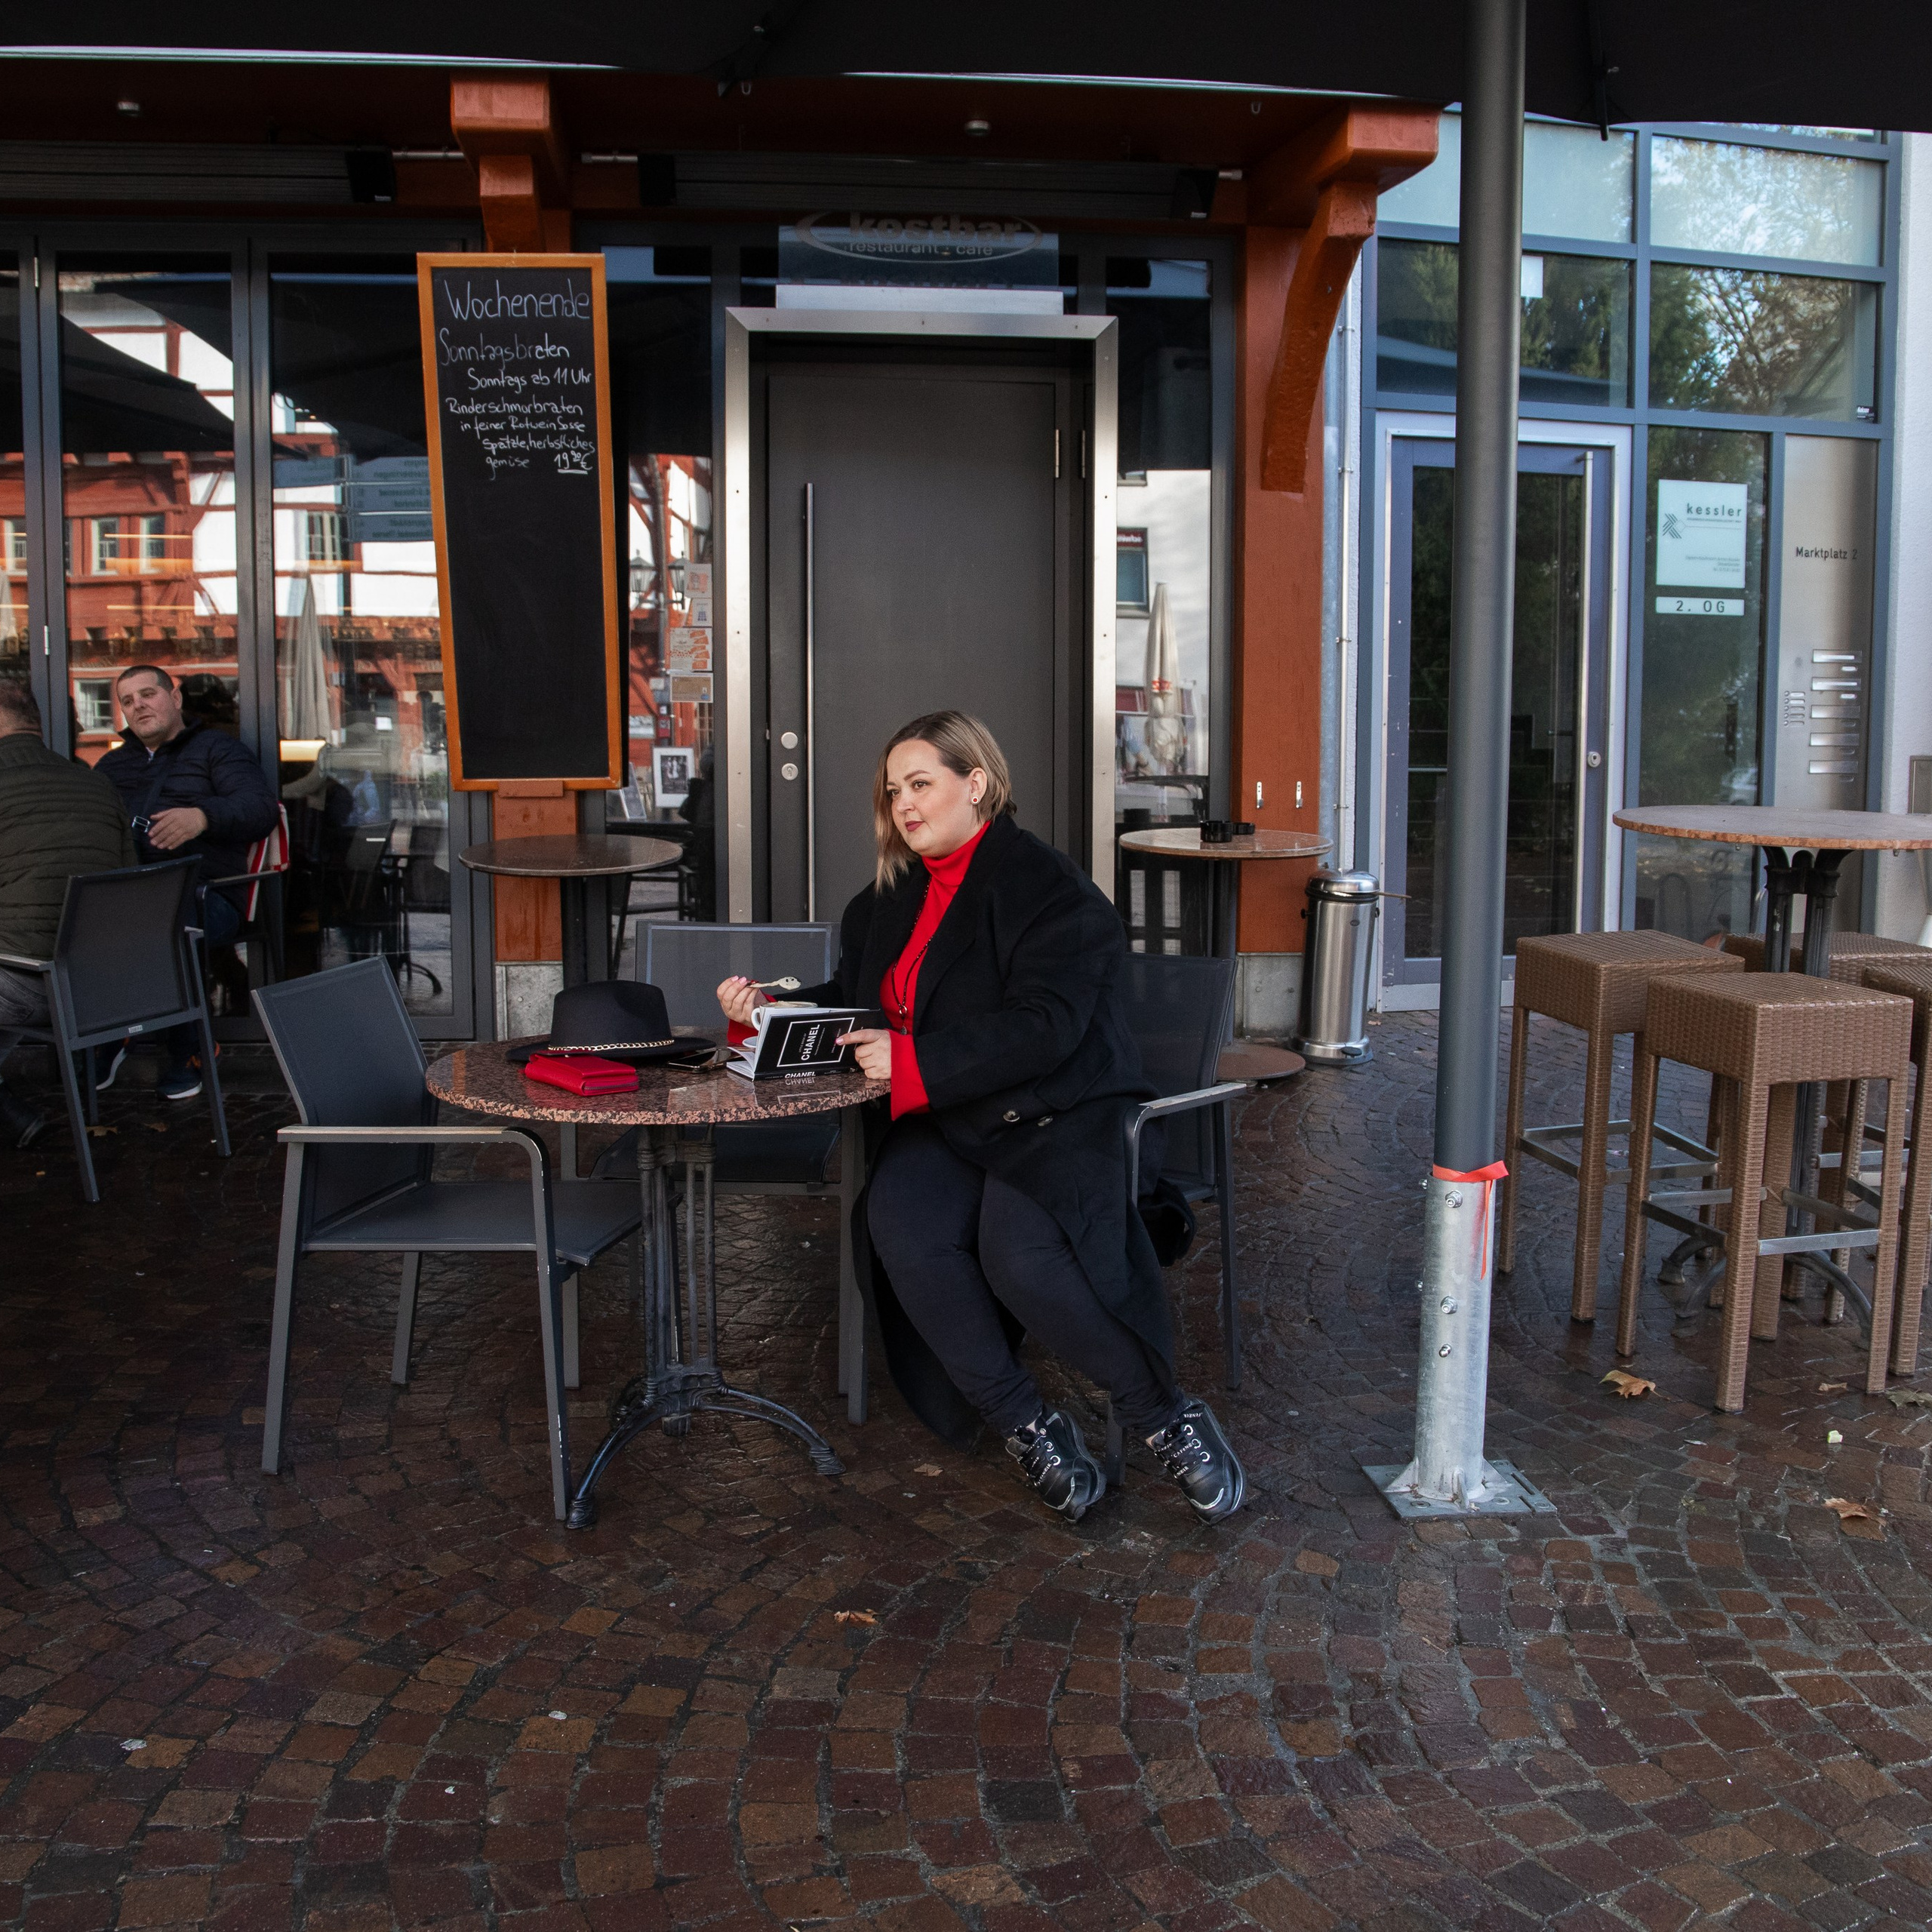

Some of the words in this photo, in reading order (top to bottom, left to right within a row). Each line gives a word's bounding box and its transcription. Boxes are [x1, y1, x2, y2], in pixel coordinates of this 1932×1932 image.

[849, 211, 1022, 240] kostbar
[849, 242, 939, 254] restaurant
[444, 278, 590, 321] Wochenende
[439, 328, 570, 371] Sonntagsbraten
[467, 368, 528, 394] Sonntags
[531, 368, 551, 386] ab
[553, 367, 568, 385] 11
[570, 368, 592, 385] Uhr
[460, 420, 472, 432] in
[474, 415, 506, 440] feiner
[1686, 503, 1742, 518] kessler
[1795, 546, 1848, 561] Marktplatz
[1851, 549, 1858, 560] 2
[1675, 600, 1691, 612] 2.
[1703, 601, 1725, 613] OG
[801, 1024, 820, 1060] CHANEL
